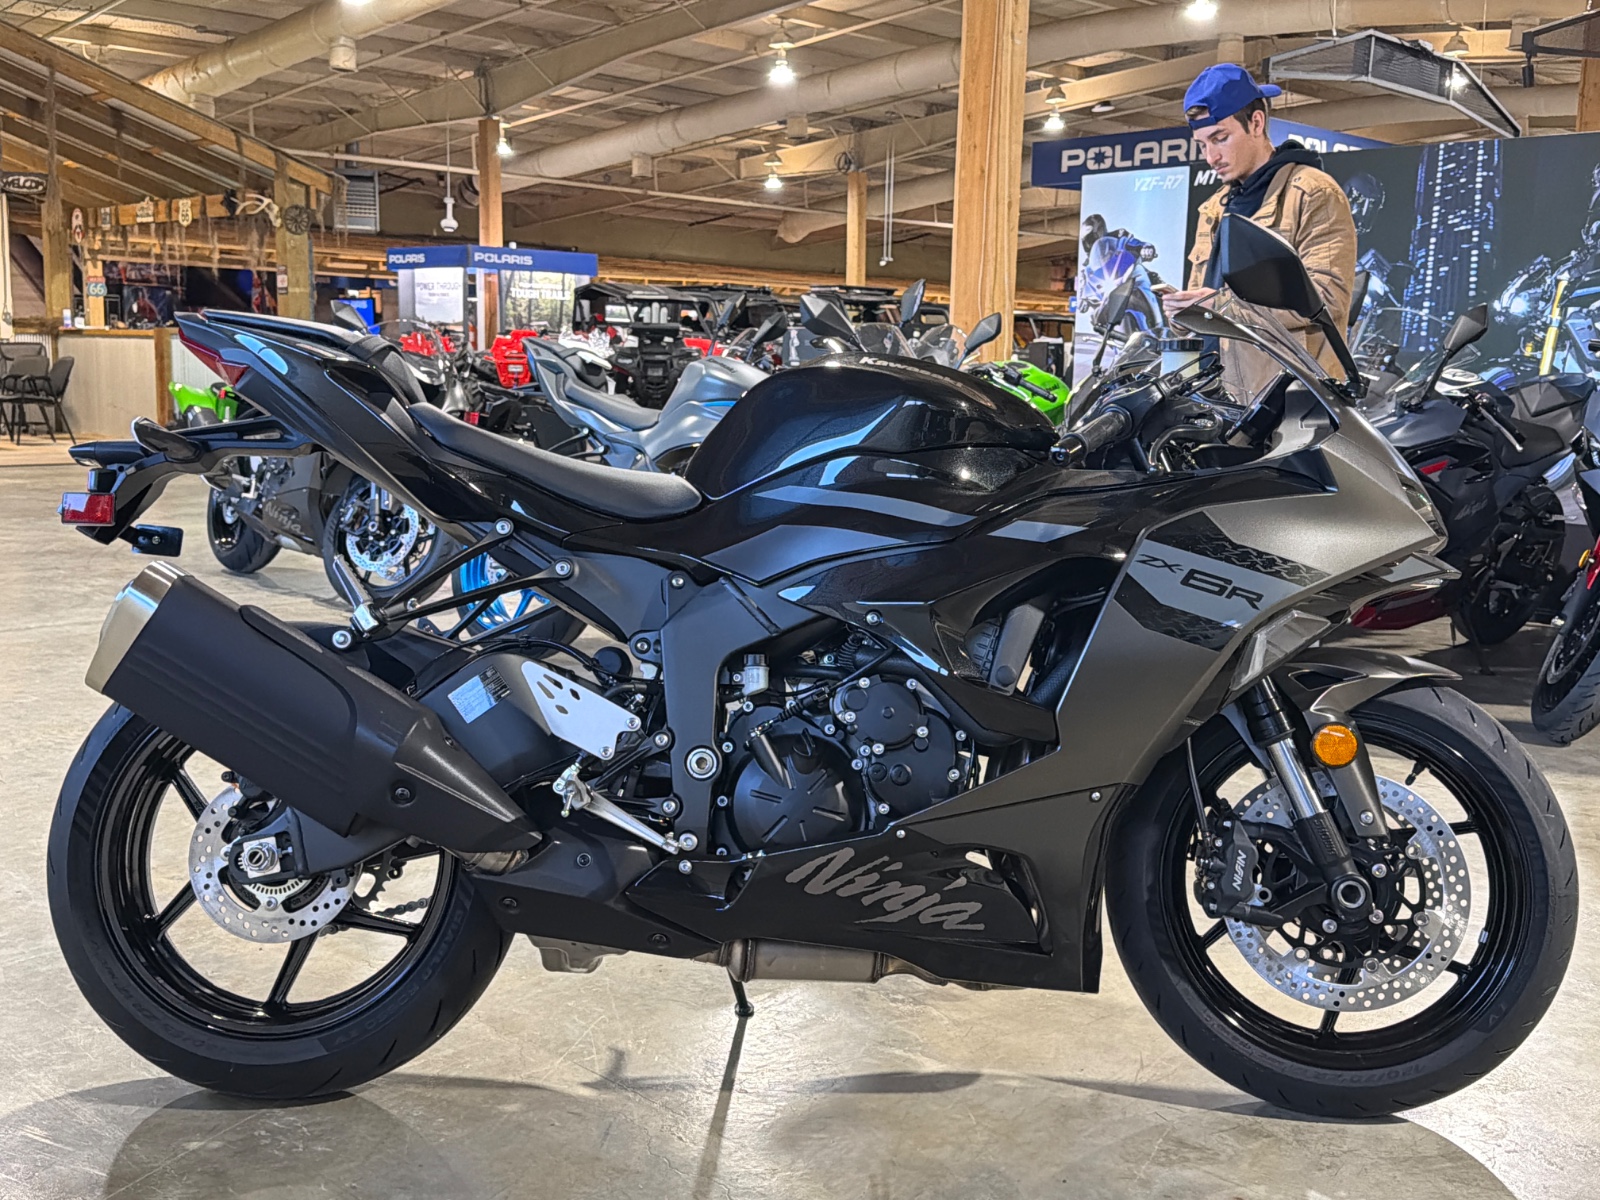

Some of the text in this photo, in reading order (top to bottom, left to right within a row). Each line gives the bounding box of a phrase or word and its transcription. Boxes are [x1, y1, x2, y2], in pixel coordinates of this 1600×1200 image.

[1133, 174, 1184, 192] YZF-R7
[388, 253, 426, 264] POLARIS
[474, 252, 534, 266] POLARIS
[89, 282, 105, 295] 66
[510, 288, 571, 301] TOUGH TRAILS
[264, 501, 305, 536] Ninja
[1135, 553, 1265, 611] ZX-6R
[785, 847, 986, 930] Ninja
